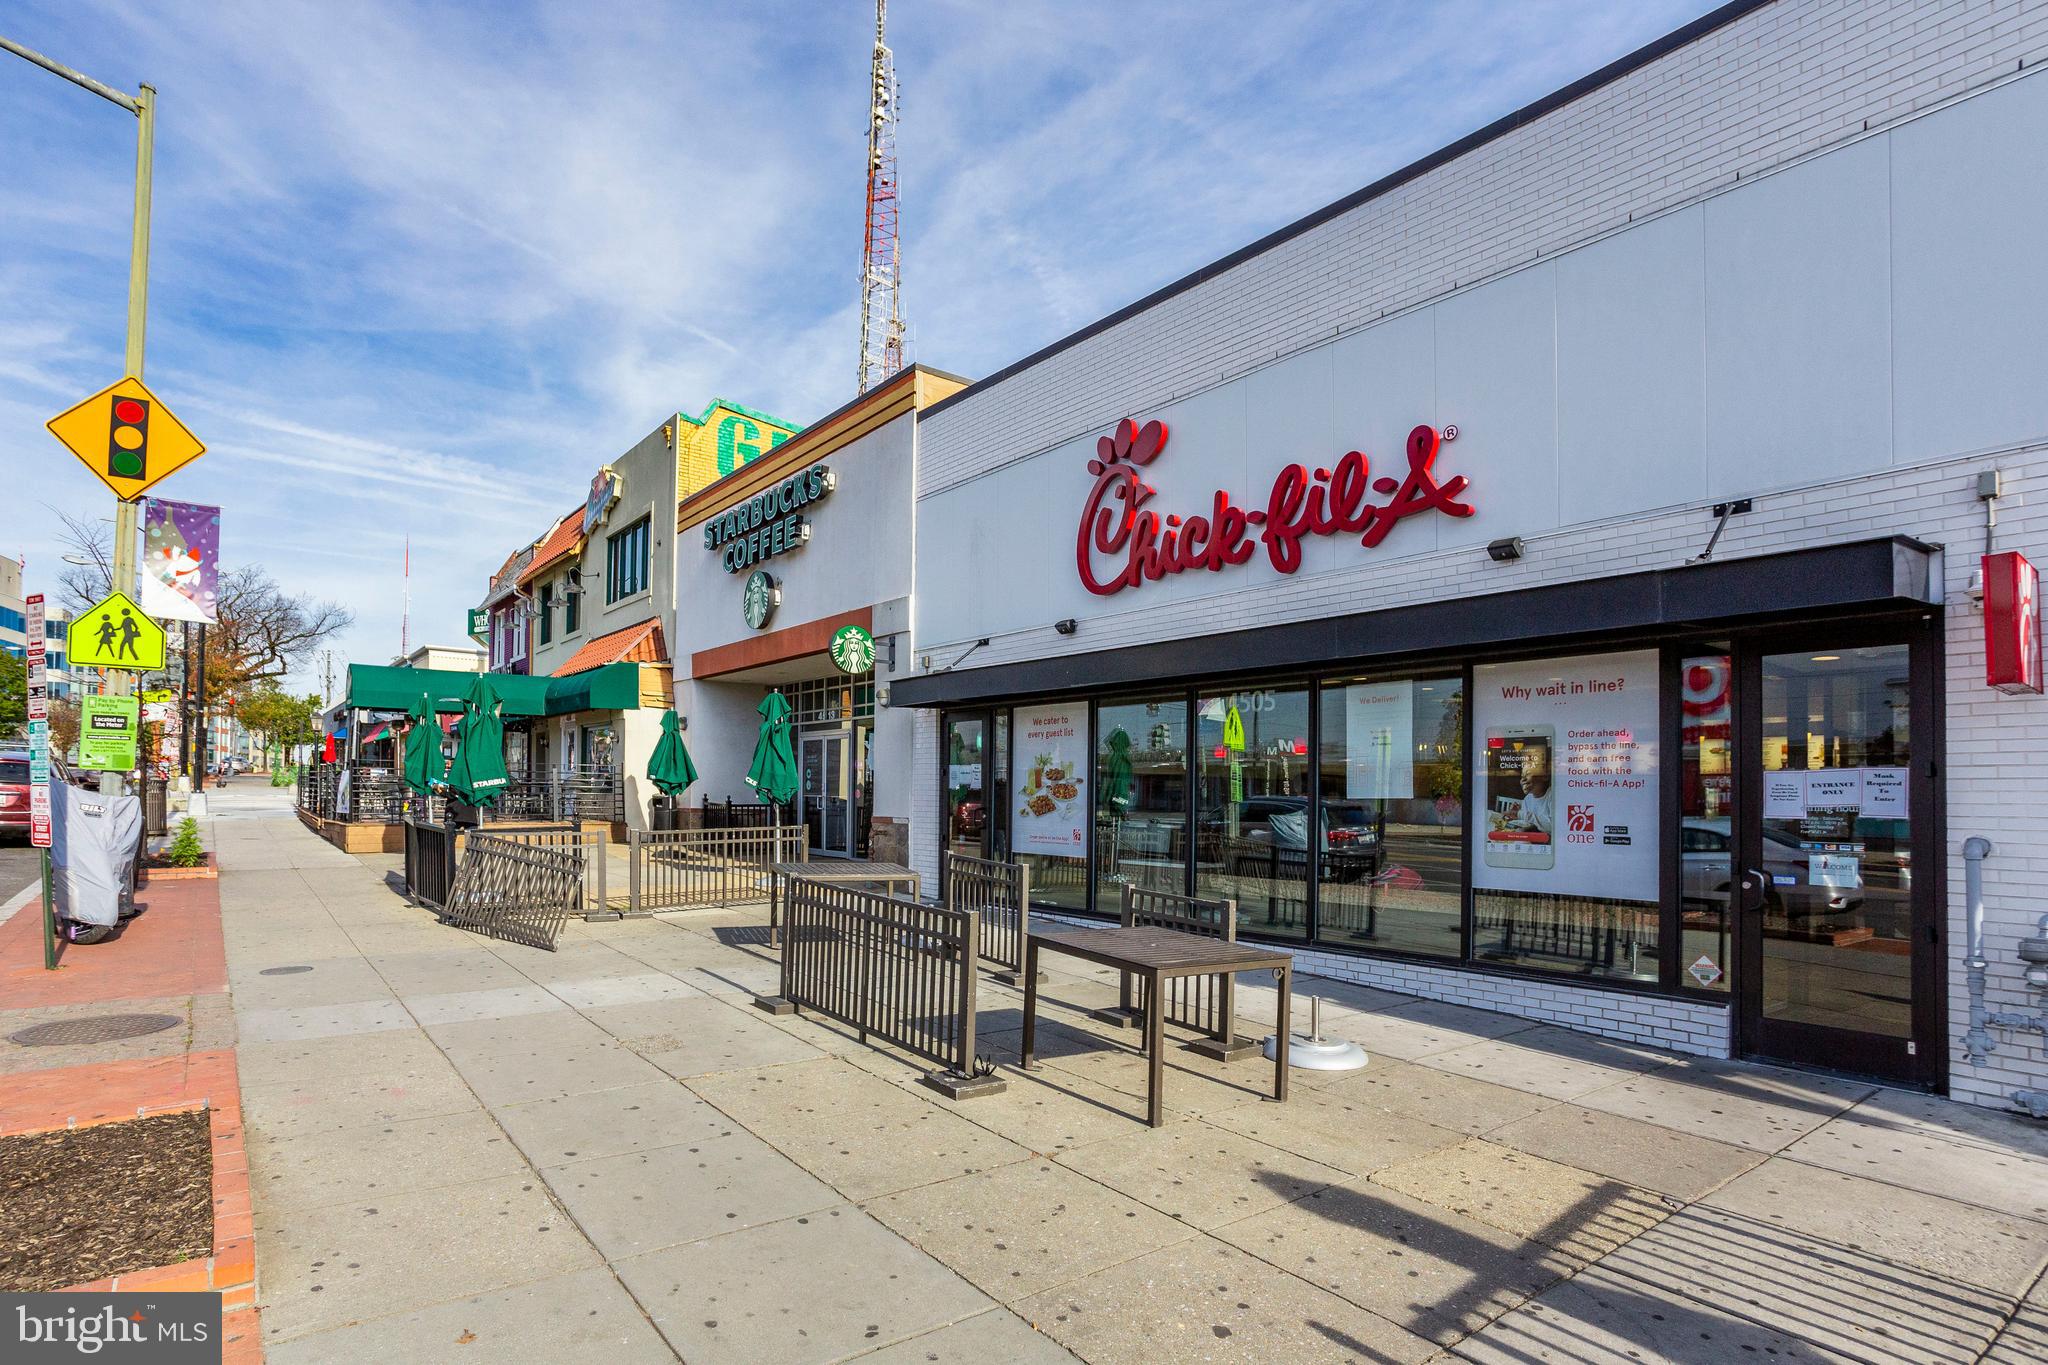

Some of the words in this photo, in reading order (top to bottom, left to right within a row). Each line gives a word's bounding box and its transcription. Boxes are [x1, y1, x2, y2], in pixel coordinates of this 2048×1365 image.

[717, 415, 788, 478] G
[703, 463, 829, 551] STARBUCKS
[1076, 424, 1475, 595] Chick-fil-A
[722, 514, 803, 574] COFFEE
[1502, 686, 1531, 700] Why
[1536, 682, 1566, 696] wait
[1571, 681, 1584, 694] in
[1589, 678, 1624, 693] line?
[1033, 717, 1042, 726] We
[1043, 717, 1060, 725] cater
[1062, 715, 1069, 724] to
[1028, 731, 1044, 739] every
[1046, 729, 1063, 739] guest
[1064, 728, 1074, 736] list
[1568, 730, 1595, 738] Order
[1597, 728, 1629, 738] ahead,
[1568, 743, 1598, 752] bypass
[1592, 767, 1612, 775] with
[1568, 780, 1619, 788] Chick-fil-A
[1622, 779, 1645, 789] App!
[1567, 834, 1595, 843] one
[1815, 863, 1852, 871] WLCOME
